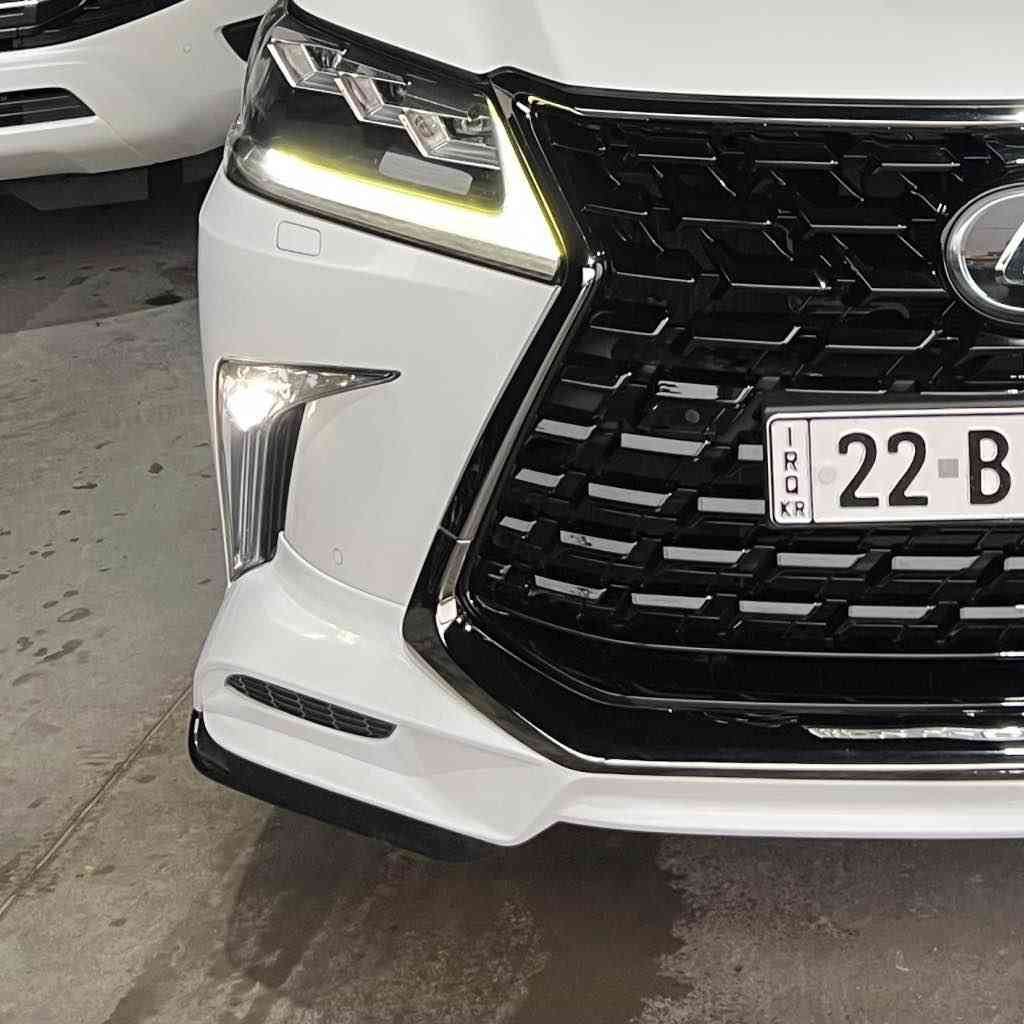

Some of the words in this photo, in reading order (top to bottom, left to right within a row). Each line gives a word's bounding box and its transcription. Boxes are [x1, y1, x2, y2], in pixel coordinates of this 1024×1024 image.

[838, 431, 929, 508] 22
[967, 429, 1012, 505] B
[780, 500, 806, 517] KR
